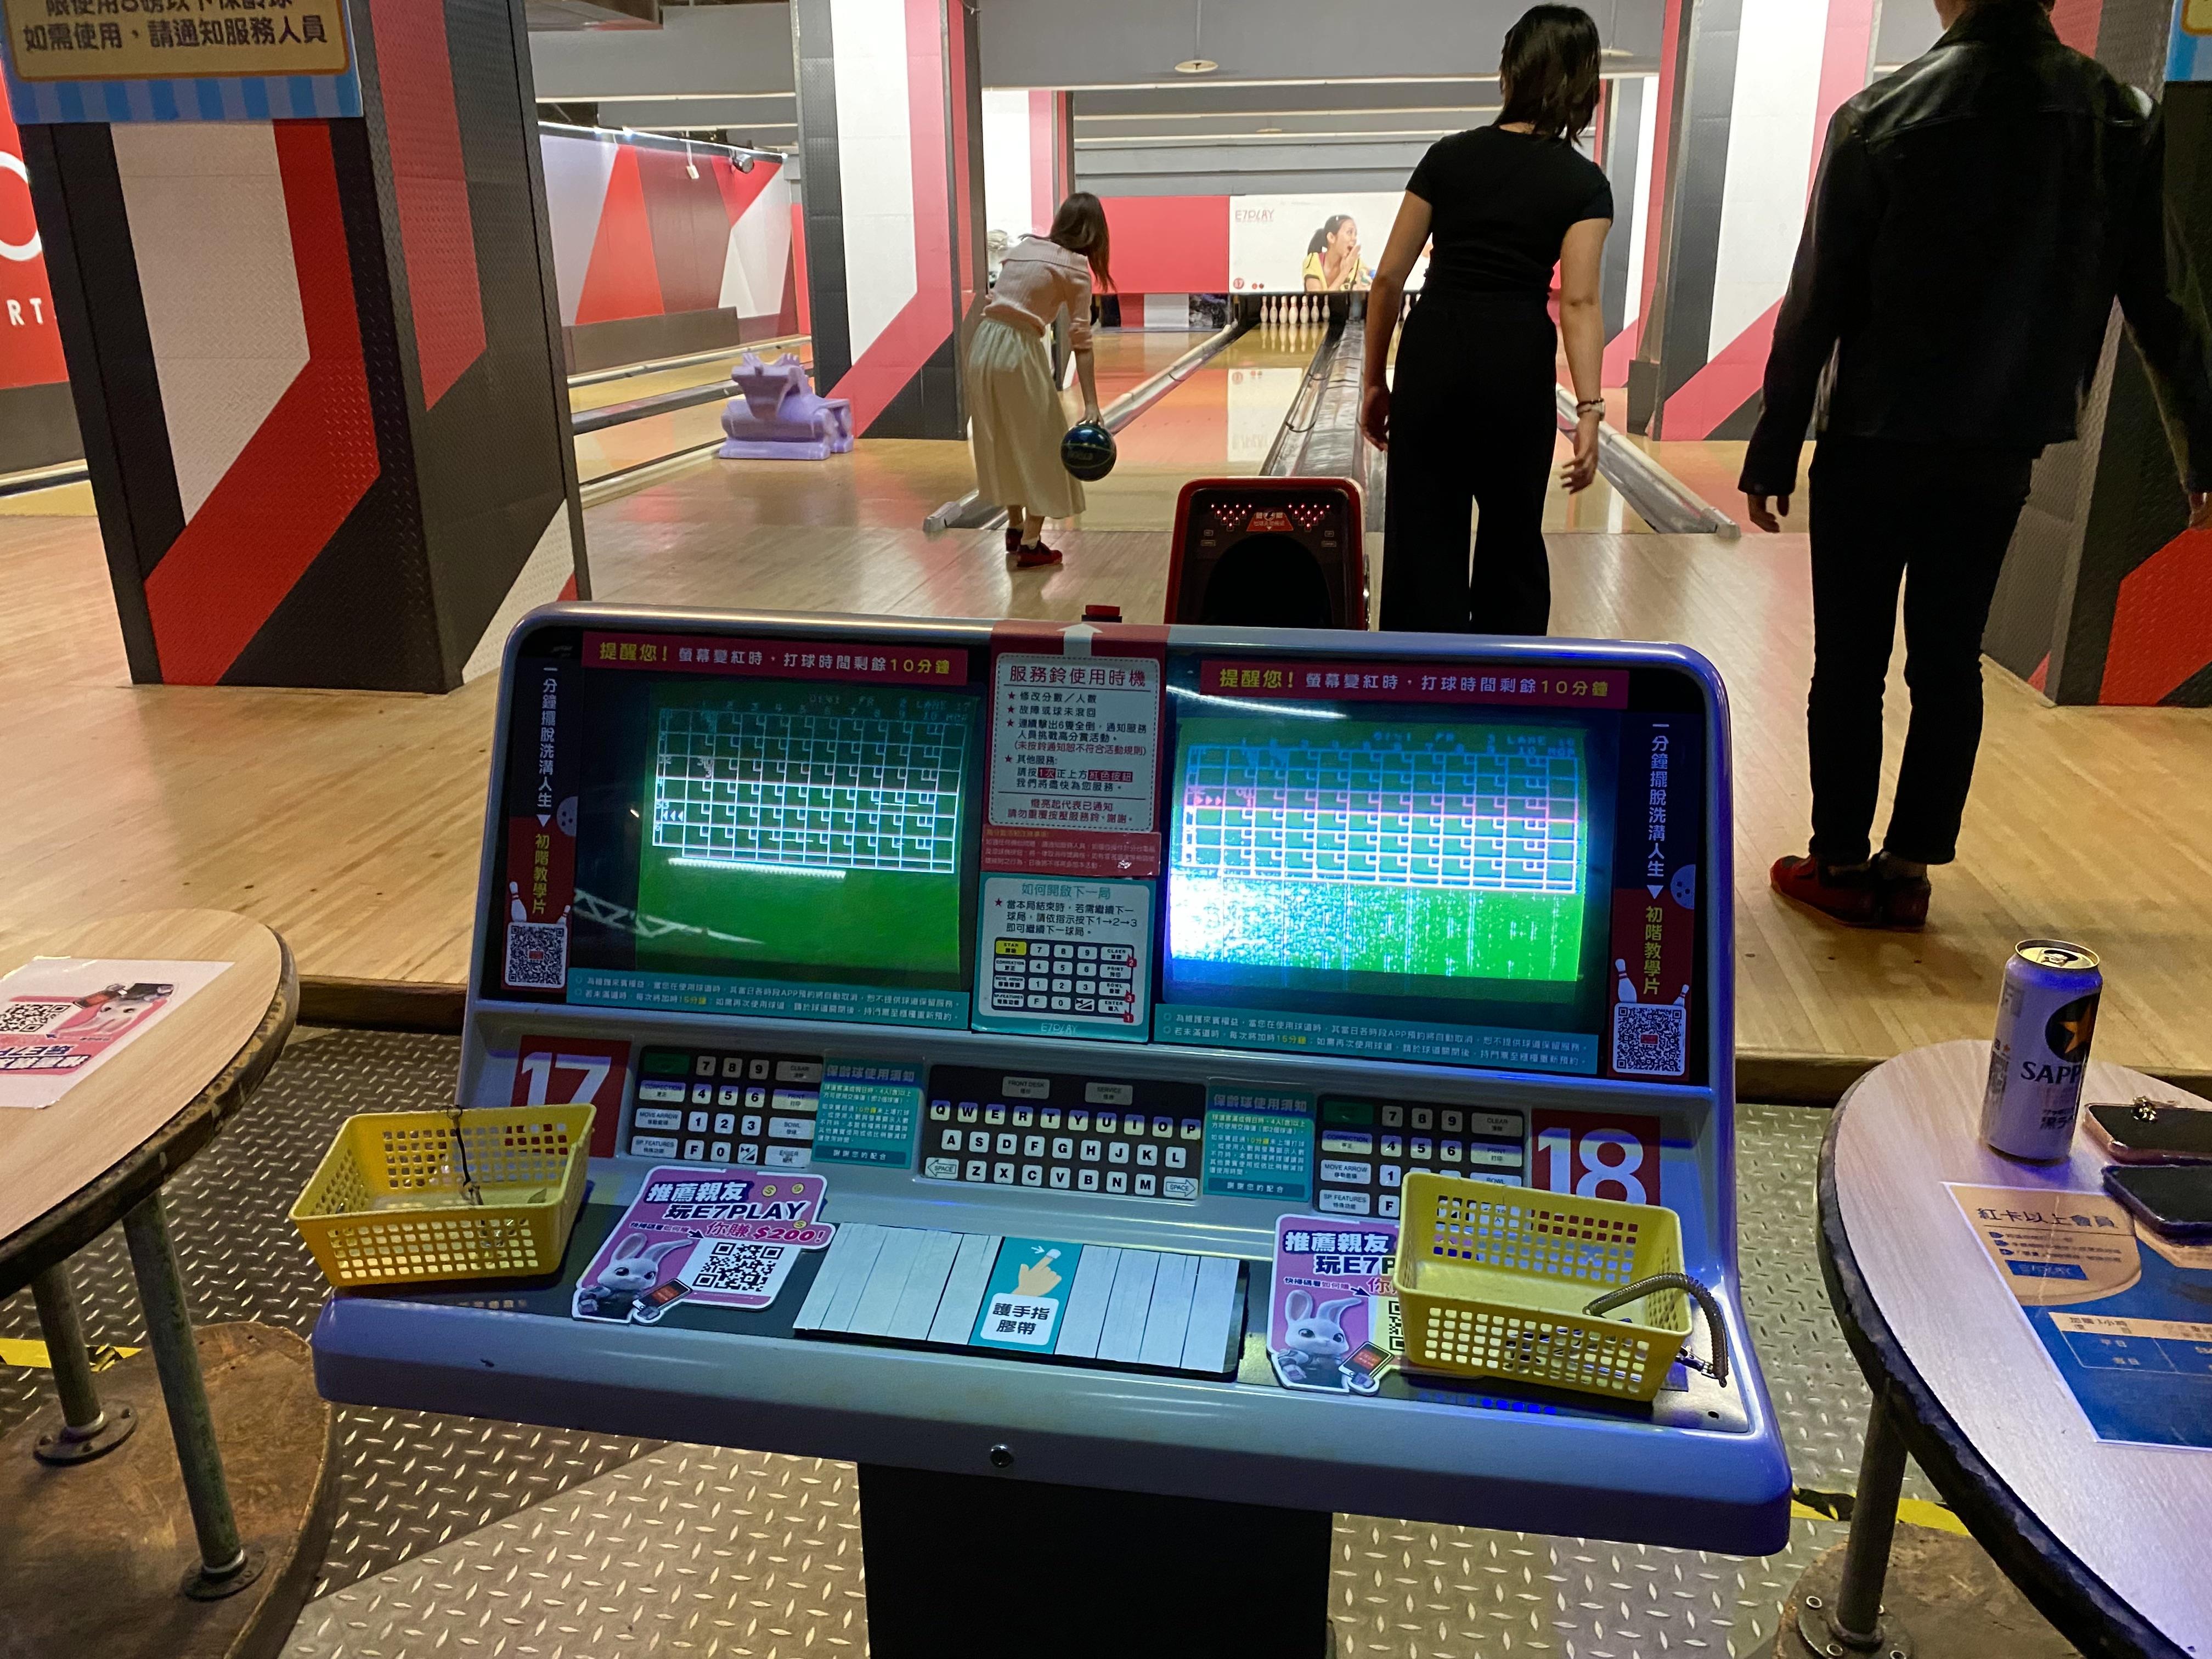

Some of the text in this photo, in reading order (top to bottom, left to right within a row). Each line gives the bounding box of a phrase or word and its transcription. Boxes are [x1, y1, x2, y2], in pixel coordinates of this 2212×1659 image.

[24, 15, 327, 52] 如需使用，請通知服務人員
[1235, 209, 1275, 221] E7PLAY
[1009, 665, 1146, 687] 服務鈴使用時機
[1647, 723, 1669, 877] 一分鐘擺脫洗溝人生
[1031, 799, 1113, 812] 燈亮起代表已通知
[532, 833, 550, 915] 初階教學片
[1007, 900, 1134, 915] 當本局結束時，若需繼續下一
[1643, 906, 1663, 995] 初階教學片
[1041, 1023, 1077, 1035] E7PLAY
[702, 1061, 710, 1071] 7
[728, 1063, 736, 1072] 8
[755, 1064, 763, 1074] 9
[521, 1051, 612, 1107] 17
[1008, 1080, 1027, 1088] FRONT
[698, 1089, 706, 1098] 4
[724, 1091, 732, 1100] 5
[751, 1092, 758, 1102] 6
[936, 1105, 945, 1116] Q
[962, 1107, 974, 1118] W
[991, 1109, 999, 1119] E
[1018, 1111, 1028, 1121] R
[1047, 1113, 1055, 1123] T
[1074, 1116, 1083, 1125] Y
[1389, 1111, 1396, 1121] 7
[1418, 1114, 1426, 1124] 8
[1448, 1116, 1457, 1126] 9
[696, 1118, 701, 1126] 1
[720, 1119, 729, 1128] 2
[747, 1121, 755, 1130] 3
[1103, 1118, 1111, 1127] U
[1158, 1122, 1167, 1132] O
[1187, 1125, 1195, 1134] P
[946, 1135, 956, 1145] A
[975, 1137, 983, 1147] S
[1003, 1139, 1011, 1149] D
[690, 1146, 698, 1155] F
[1031, 1142, 1039, 1151] F
[1058, 1143, 1068, 1153] G
[1086, 1146, 1096, 1155] H
[1387, 1141, 1395, 1151] 4
[1417, 1143, 1425, 1153] 5
[1447, 1146, 1455, 1156] 6
[1115, 1148, 1122, 1158] J
[1142, 1150, 1152, 1160] K
[1172, 1153, 1180, 1163] L
[972, 1166, 980, 1176] Z
[1538, 1127, 1647, 1205] 18
[999, 1169, 1008, 1178] X
[1028, 1171, 1036, 1181] C
[1056, 1173, 1064, 1183] V
[1388, 1171, 1393, 1181] 1
[1084, 1176, 1092, 1185] B
[1113, 1178, 1121, 1187] N
[1141, 1180, 1150, 1190] M
[646, 1181, 747, 1203] 推薦親友
[1169, 1184, 1189, 1192] SPACE
[1334, 1194, 1366, 1203] FEATURES
[664, 1200, 809, 1221] 玩E7PLAY
[1386, 1201, 1393, 1210] F
[752, 1227, 826, 1243] $200!
[1284, 1231, 1389, 1254] 推薦親友
[1368, 1277, 1397, 1294] 你
[992, 1302, 1050, 1320] 護手指
[996, 1319, 1036, 1335] 膠帶
